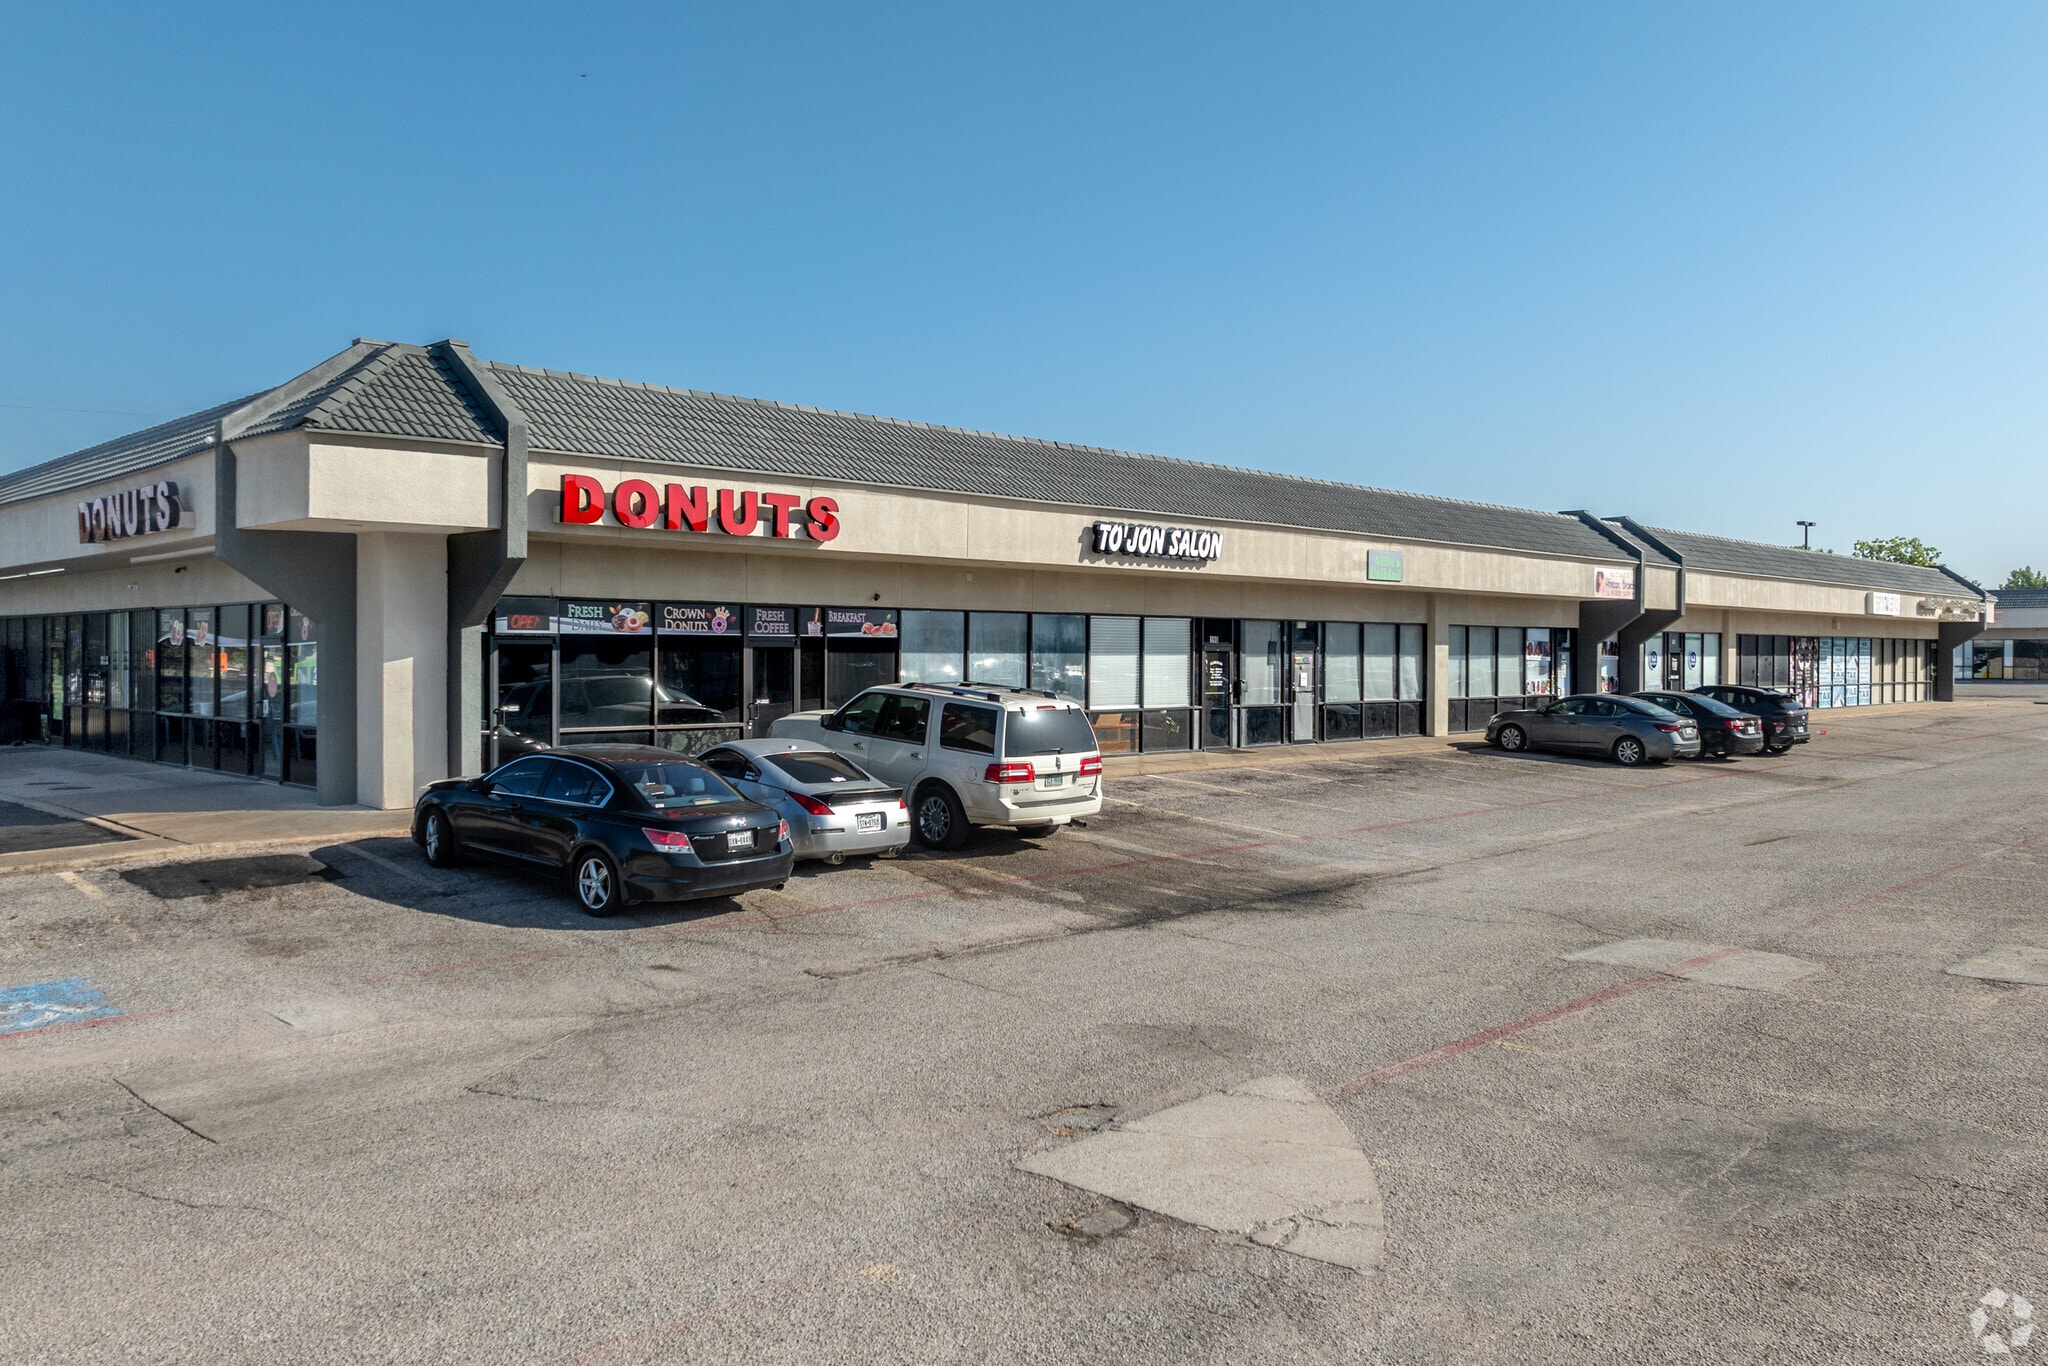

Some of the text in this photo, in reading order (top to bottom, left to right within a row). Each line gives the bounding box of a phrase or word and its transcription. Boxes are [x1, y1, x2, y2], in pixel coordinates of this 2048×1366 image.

[78, 481, 177, 544] DONUTS
[560, 474, 841, 542] DONUTS
[1099, 523, 1224, 559] TO'JON SALON
[567, 604, 604, 618] FRESH
[663, 606, 706, 620] CROWN
[755, 609, 785, 621] FRESH
[828, 610, 866, 623] BREAKFAST
[571, 618, 605, 632] DAILY
[664, 619, 709, 632] DONUTS
[754, 621, 790, 634] COFFEE
